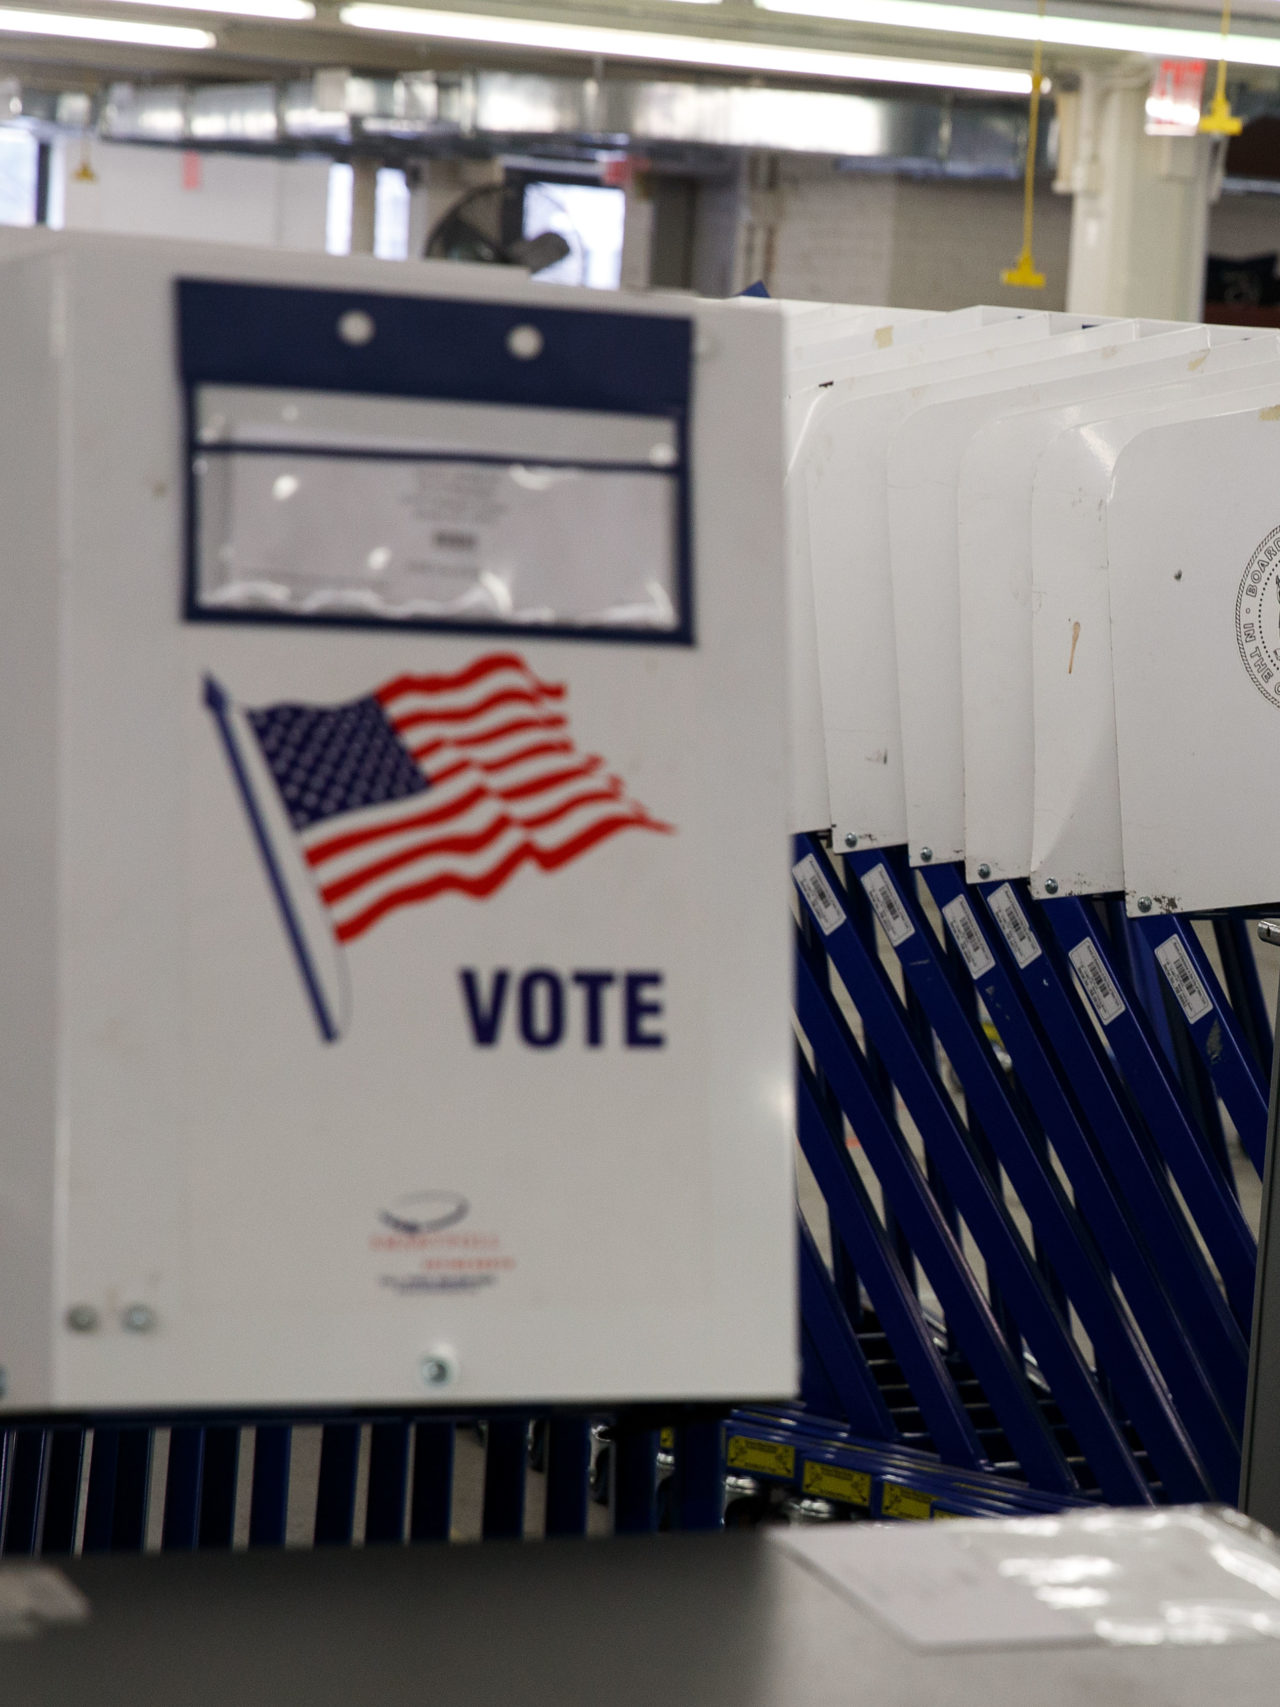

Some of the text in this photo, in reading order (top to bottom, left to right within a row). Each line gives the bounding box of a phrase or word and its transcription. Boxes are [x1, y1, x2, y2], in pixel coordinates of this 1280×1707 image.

[1243, 623, 1256, 643] IN
[1250, 646, 1273, 683] THE
[458, 966, 665, 1048] VOTE
